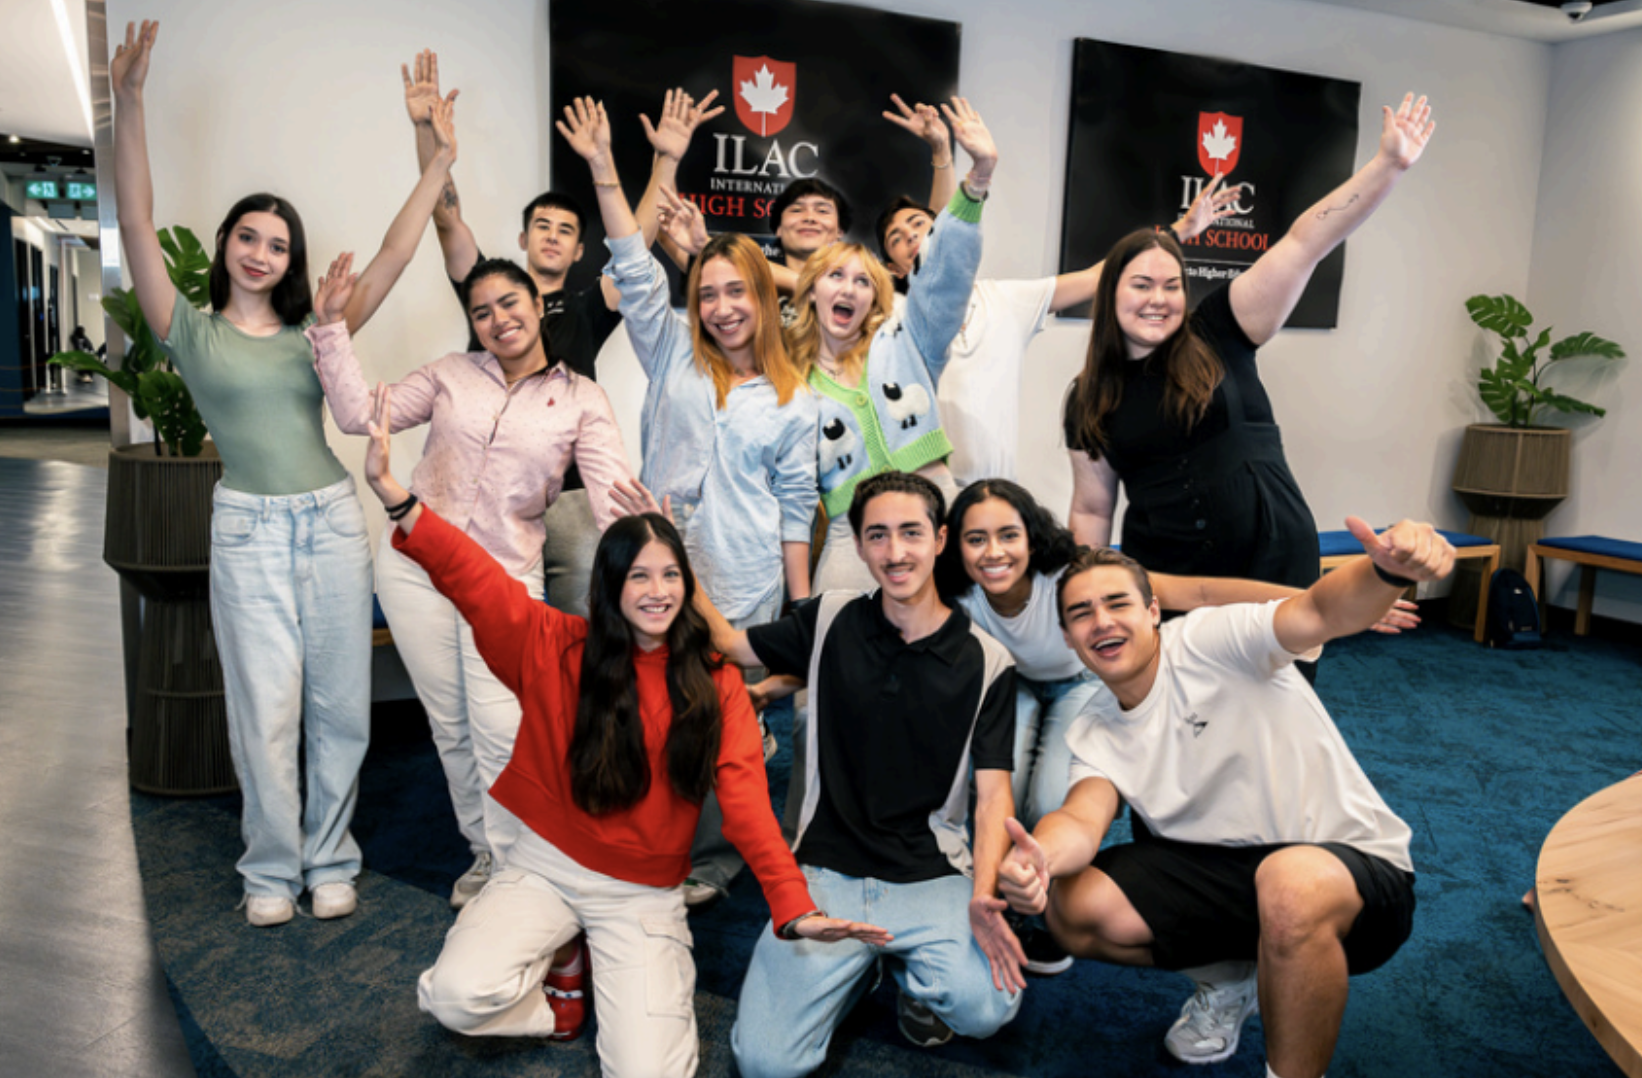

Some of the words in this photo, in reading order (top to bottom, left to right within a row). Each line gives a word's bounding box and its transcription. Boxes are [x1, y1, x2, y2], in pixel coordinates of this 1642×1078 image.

[712, 132, 819, 179] ILAC
[710, 177, 785, 195] INTERNATI
[1205, 229, 1271, 252] SCHOOL
[1198, 267, 1227, 281] Higher
